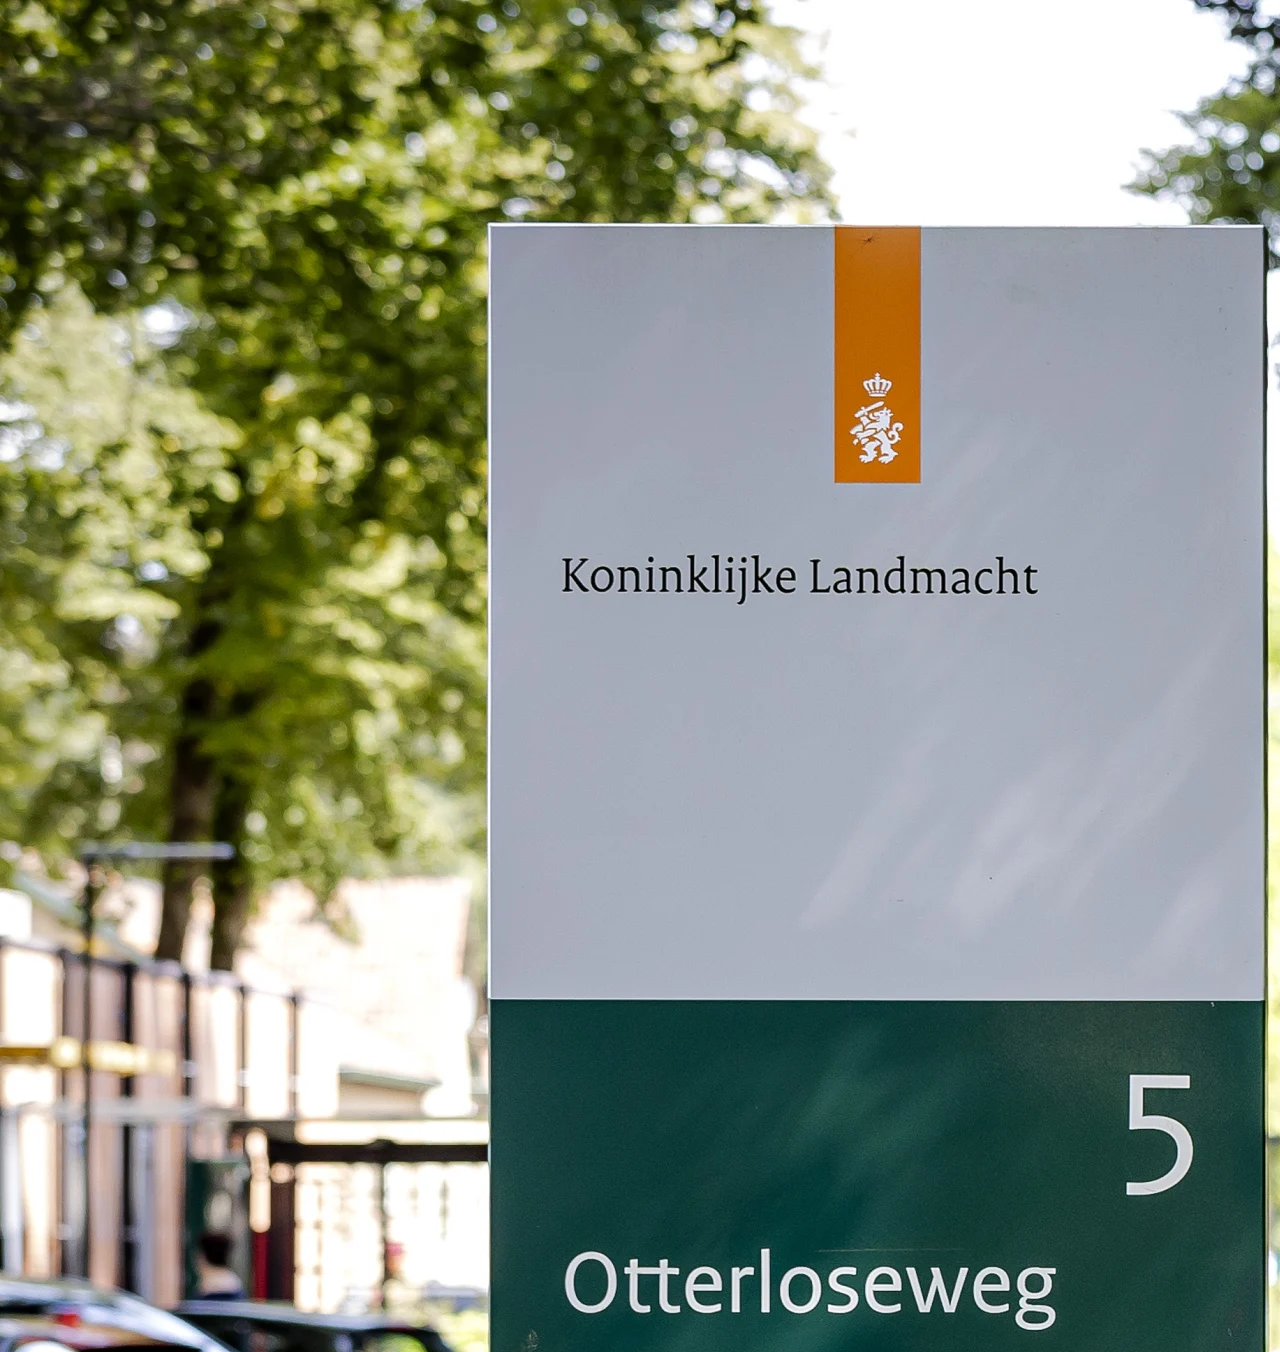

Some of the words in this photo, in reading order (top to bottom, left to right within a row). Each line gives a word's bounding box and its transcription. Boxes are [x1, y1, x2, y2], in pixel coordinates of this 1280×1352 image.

[561, 554, 797, 605] Koninklijke
[809, 555, 1039, 596] Landmacht
[1125, 1074, 1194, 1196] 5
[564, 1248, 1057, 1331] Otterloseweg
